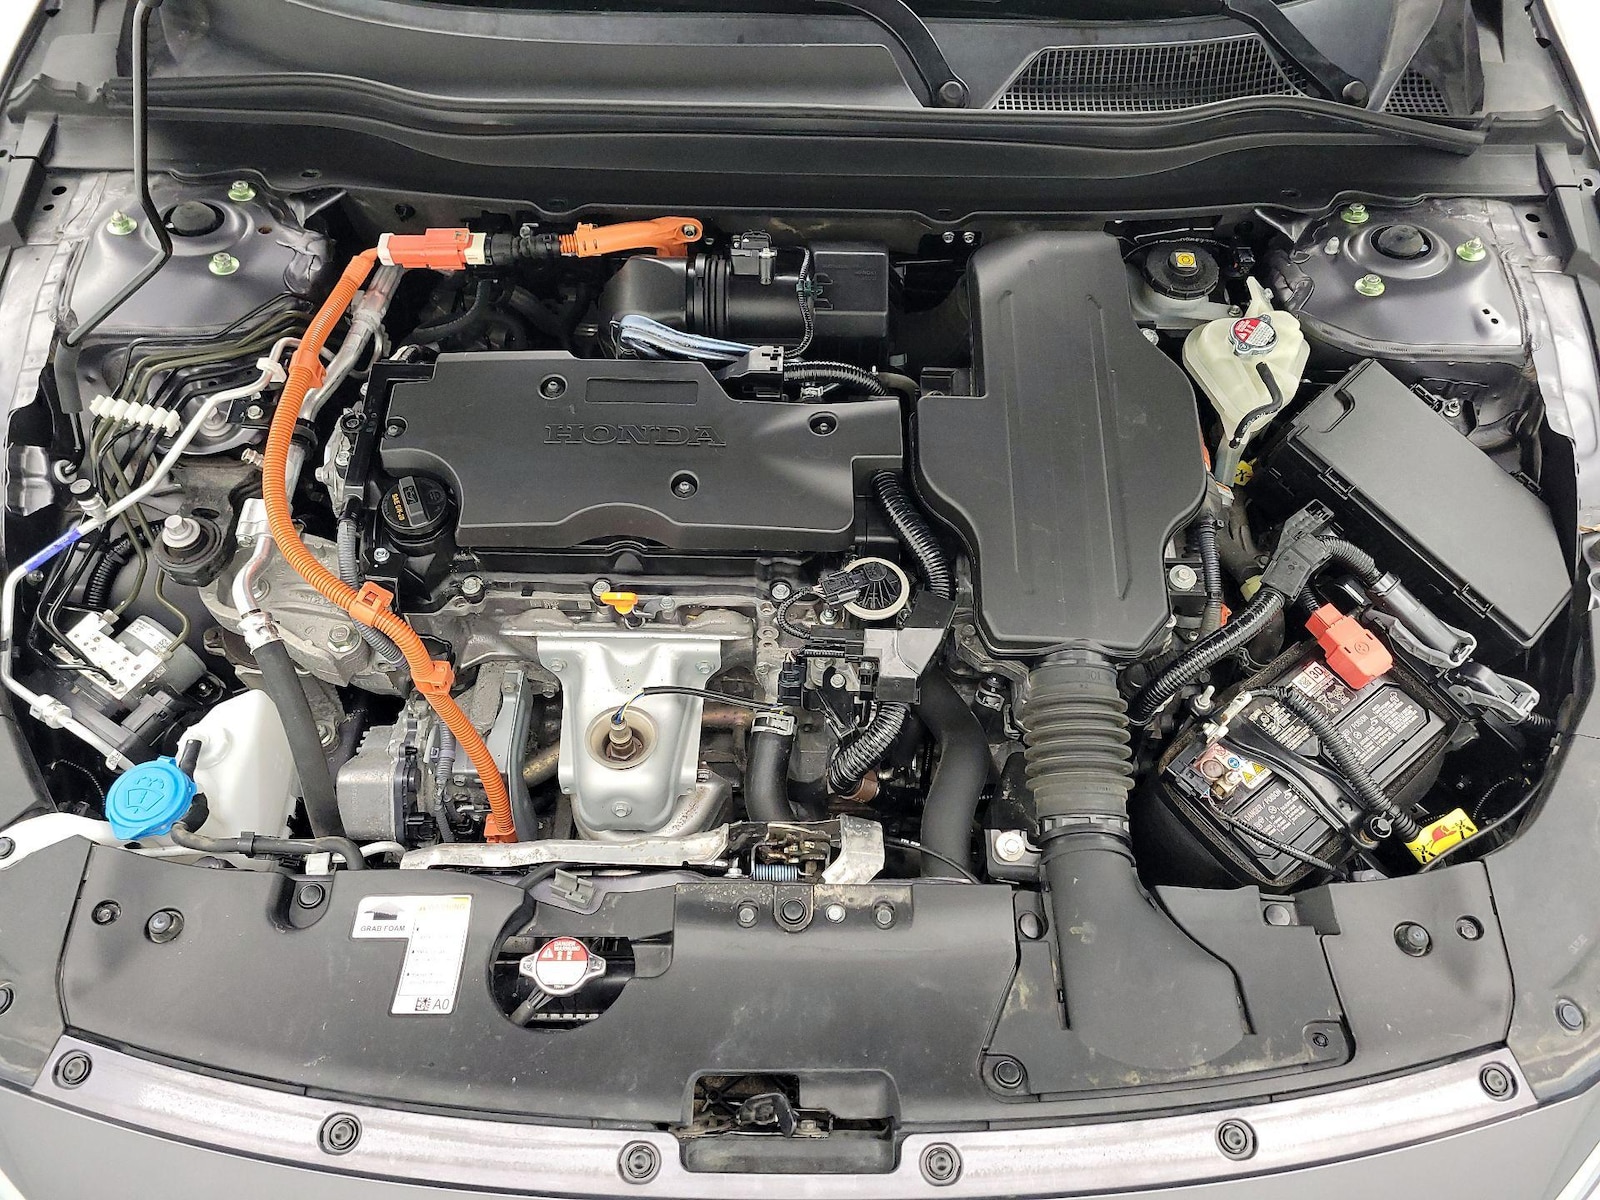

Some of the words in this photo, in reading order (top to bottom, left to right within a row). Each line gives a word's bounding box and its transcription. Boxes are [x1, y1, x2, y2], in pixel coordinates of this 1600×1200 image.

[543, 423, 728, 447] HONDA
[1309, 665, 1324, 679] 3D
[1263, 787, 1282, 805] POISON
[432, 998, 450, 1010] A0
